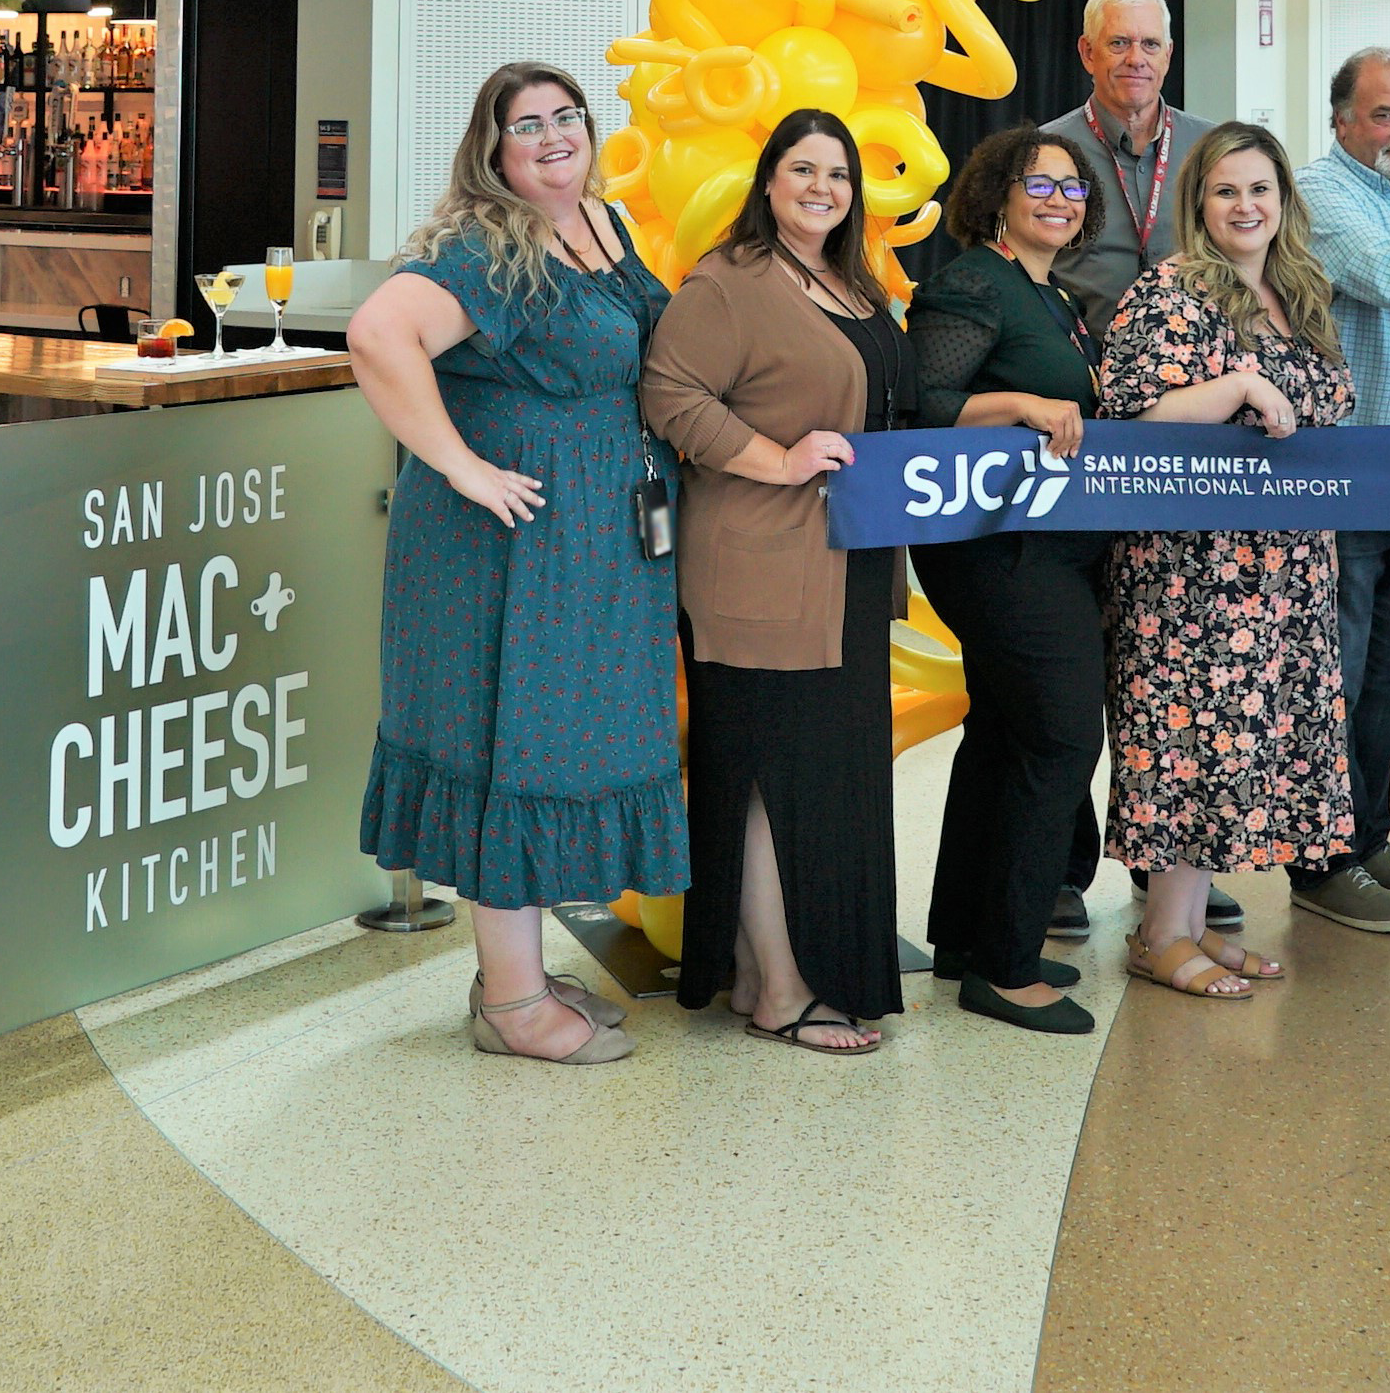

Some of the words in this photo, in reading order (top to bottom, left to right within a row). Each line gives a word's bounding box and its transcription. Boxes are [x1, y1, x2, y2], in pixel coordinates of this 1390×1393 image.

[83, 480, 164, 549] SAN
[189, 464, 287, 533] JOSE
[903, 450, 1011, 518] SJC
[1083, 454, 1128, 474] SAN
[1132, 454, 1185, 475] JOSE
[1190, 456, 1273, 476] MINETA
[1084, 476, 1255, 496] INTERNATIONAL
[1260, 477, 1353, 497] AIRPORT
[87, 554, 239, 699] MAC
[48, 670, 308, 849] CHEESE
[85, 821, 277, 933] KITCHEN
